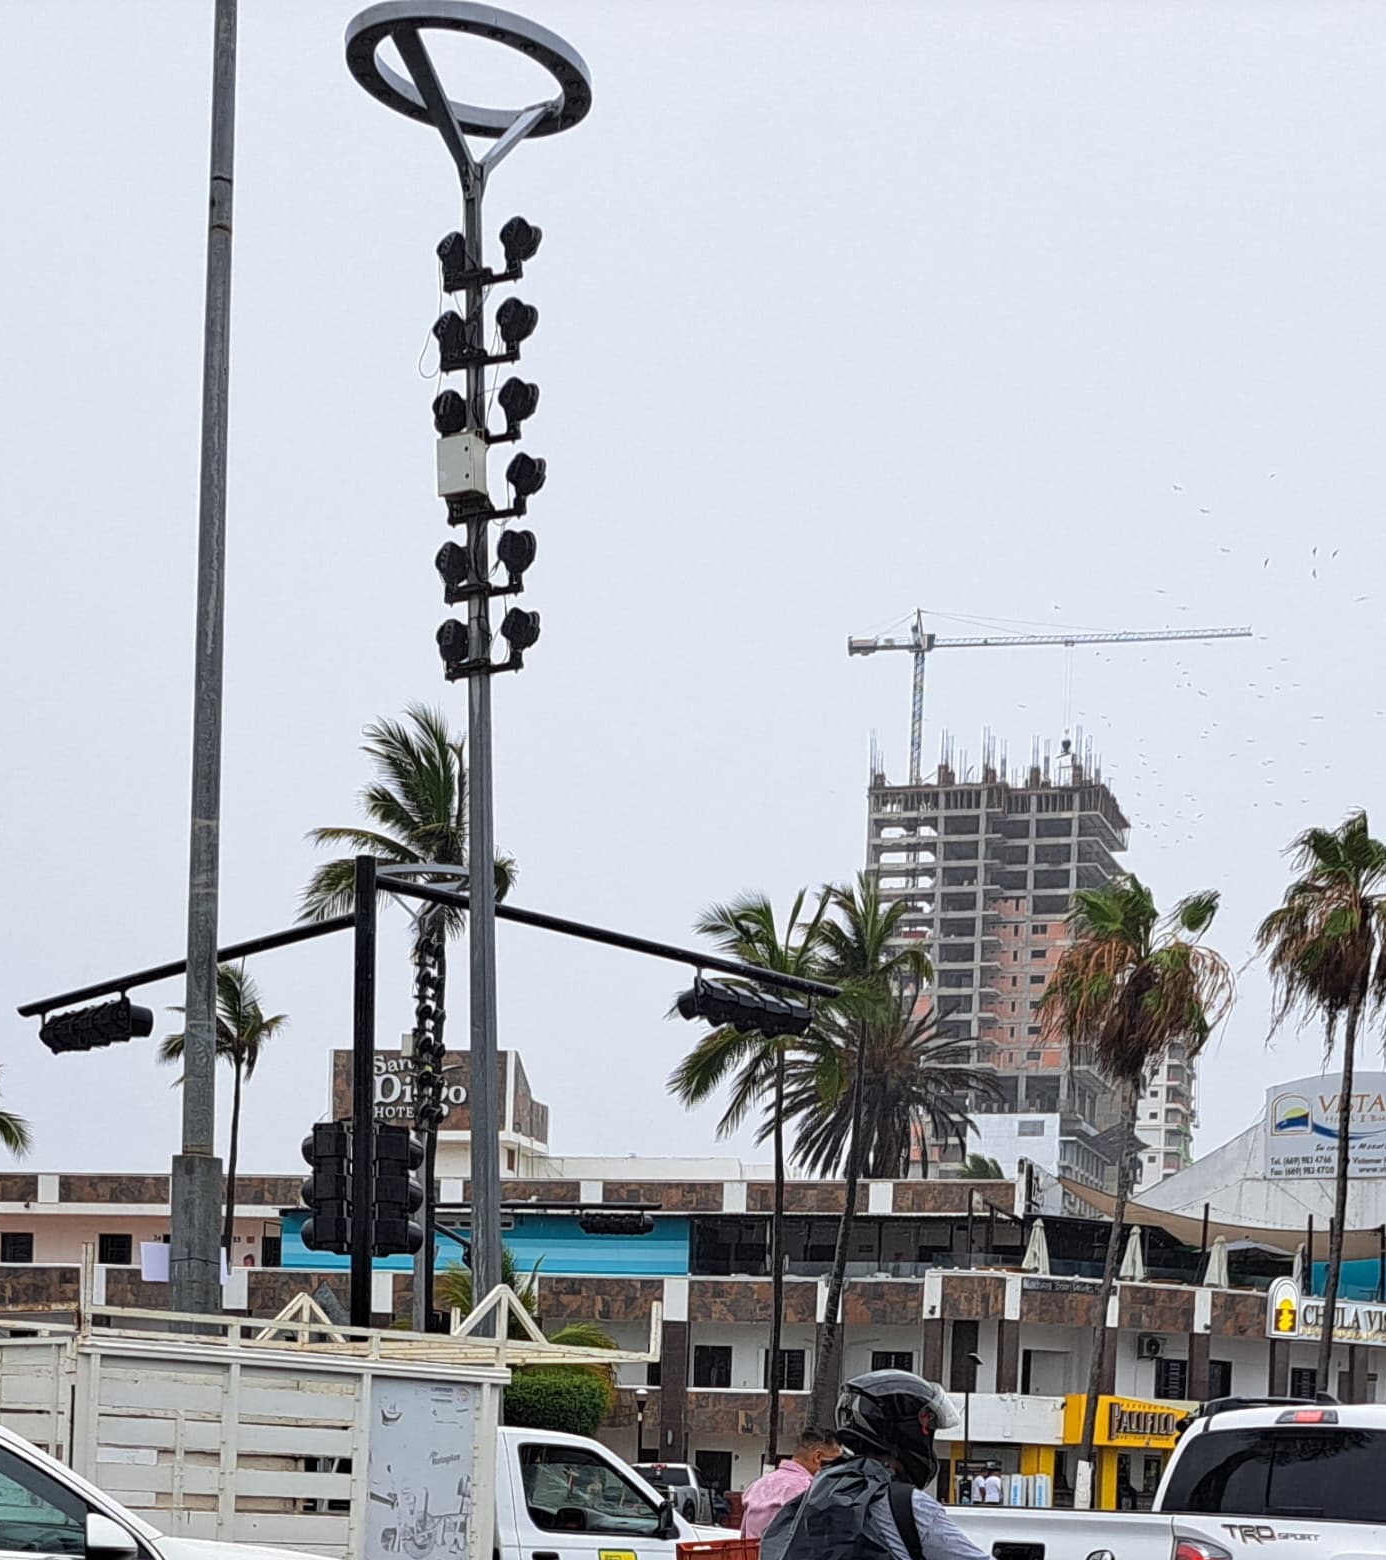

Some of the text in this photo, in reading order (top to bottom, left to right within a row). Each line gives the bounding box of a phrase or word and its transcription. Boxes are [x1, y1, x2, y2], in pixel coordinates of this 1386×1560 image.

[373, 1055, 415, 1074] San
[373, 1074, 467, 1110] Dio
[1303, 1304, 1361, 1330] CHULA
[1221, 1524, 1320, 1544] TRD SPORT
